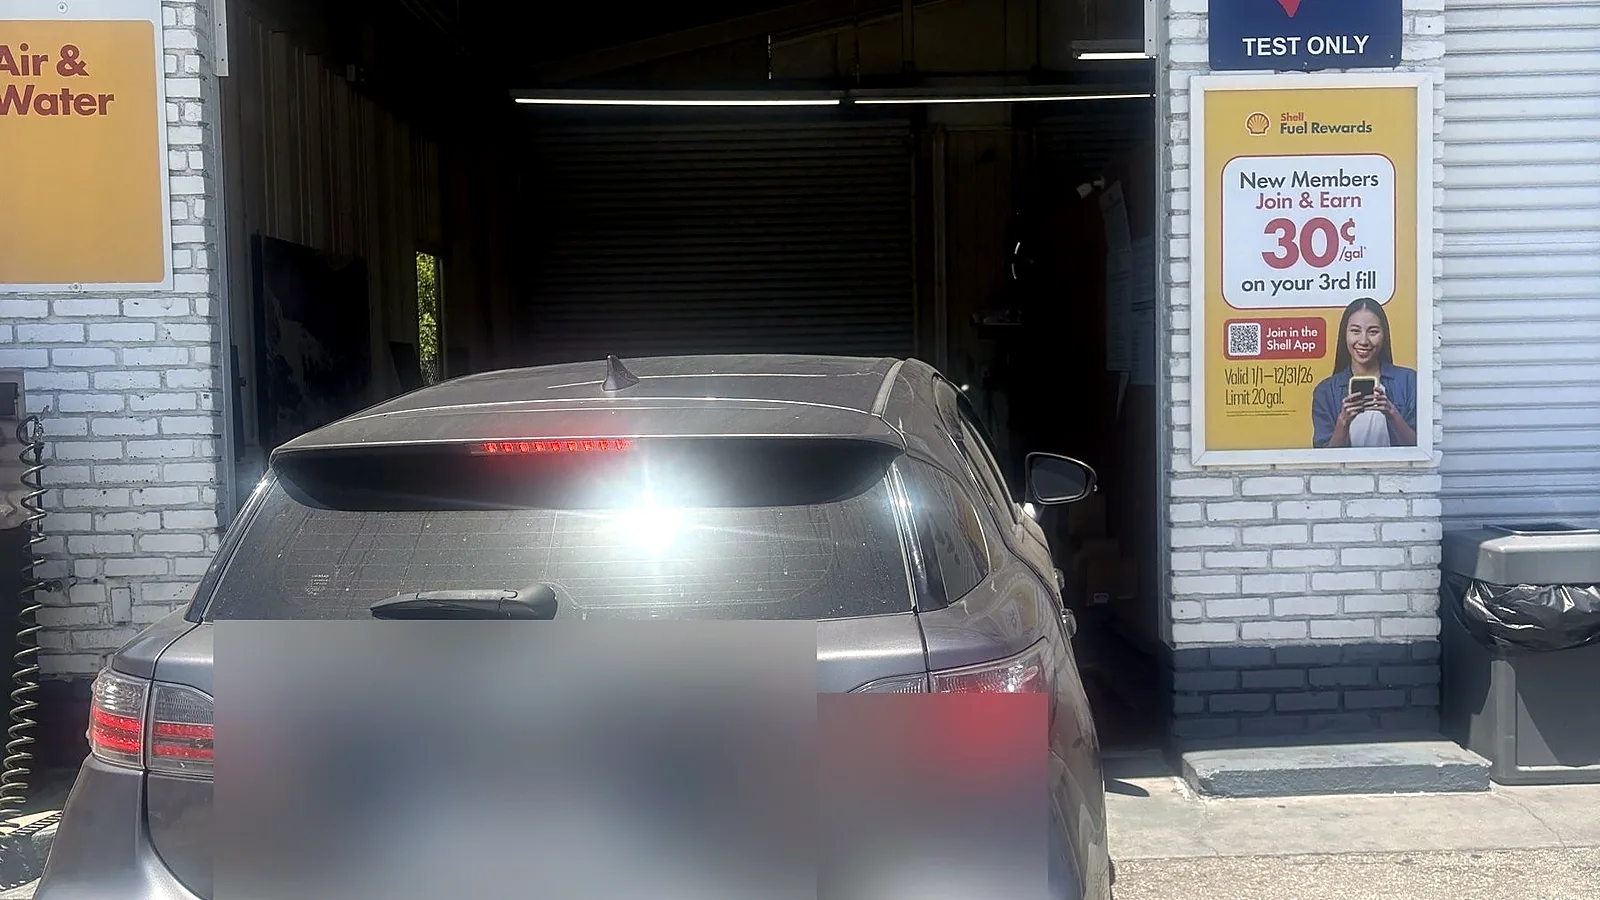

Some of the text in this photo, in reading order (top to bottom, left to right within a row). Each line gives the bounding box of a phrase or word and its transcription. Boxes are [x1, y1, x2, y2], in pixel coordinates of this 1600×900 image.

[1242, 35, 1369, 56] TEST ONLY
[0, 43, 90, 77] Air &
[0, 84, 114, 116] Water
[1280, 112, 1304, 122] Shell
[1280, 121, 1372, 134] Fuel Rewards
[1240, 169, 1379, 189] New Members
[1256, 191, 1362, 210] Join & Earn
[1241, 271, 1376, 296] on your 3rd fill
[1266, 326, 1318, 338] Join in the
[1266, 339, 1316, 352] Shell App
[1224, 366, 1249, 385] Valid
[1225, 388, 1251, 406] Limit
